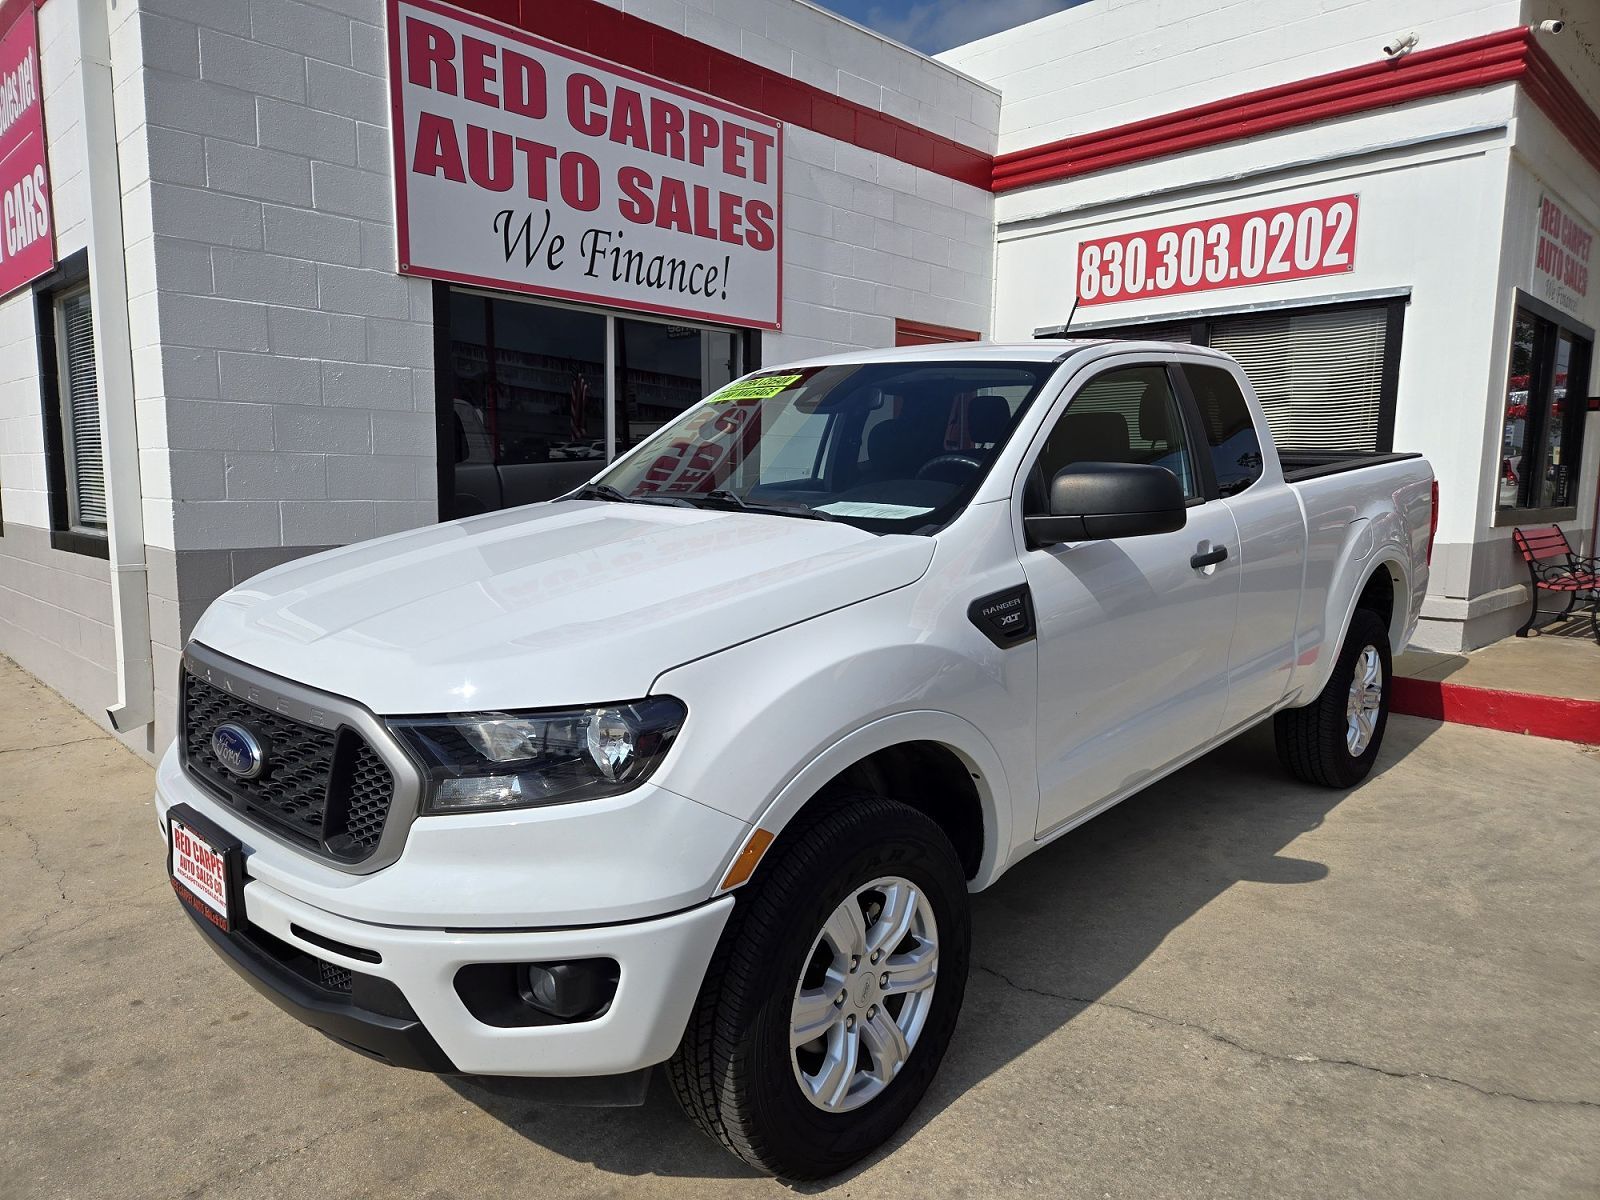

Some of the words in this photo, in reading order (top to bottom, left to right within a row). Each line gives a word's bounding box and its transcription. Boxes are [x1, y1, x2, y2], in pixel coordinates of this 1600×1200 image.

[405, 15, 547, 120] RED
[566, 72, 775, 185] CARPET
[412, 111, 601, 213] AUTO
[617, 165, 775, 252] SALES
[4, 164, 48, 257] CARS
[1541, 197, 1561, 239] RED
[493, 208, 565, 271] We
[579, 228, 731, 301] Finance!
[1079, 201, 1354, 300] 830.303.0202
[1536, 236, 1563, 281] AUTO
[983, 598, 1021, 616] RANGER
[1001, 612, 1021, 626] XLT
[216, 732, 243, 766] Ford
[174, 827, 192, 857] RED
[193, 840, 224, 881] CARPE
[180, 854, 195, 876] AUTO
[196, 865, 213, 890] SALES
